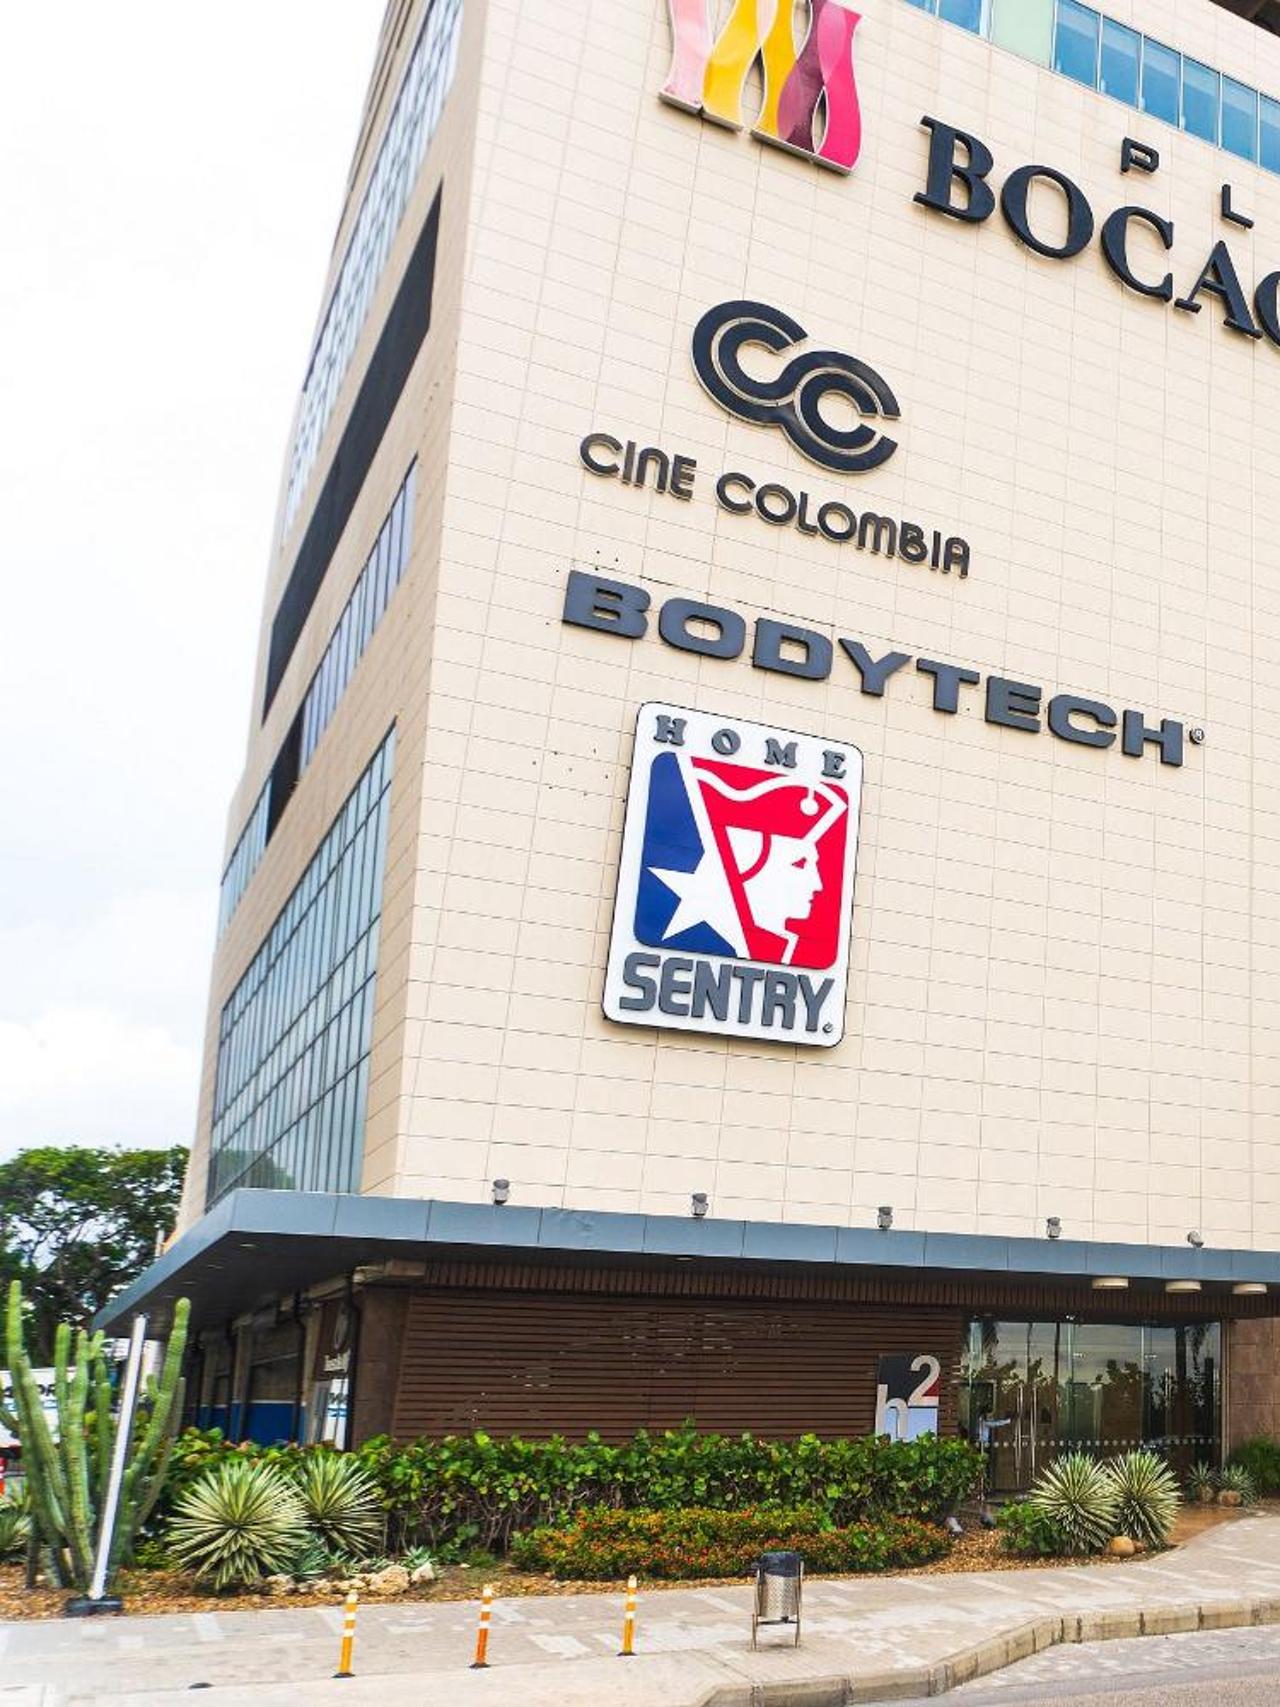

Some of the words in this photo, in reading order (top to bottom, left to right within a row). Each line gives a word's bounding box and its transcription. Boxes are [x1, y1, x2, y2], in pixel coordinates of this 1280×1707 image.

[579, 433, 698, 501] CINE
[715, 472, 971, 579] COLOMBIA
[653, 715, 848, 781] HOME
[619, 952, 835, 1033] SENTRY
